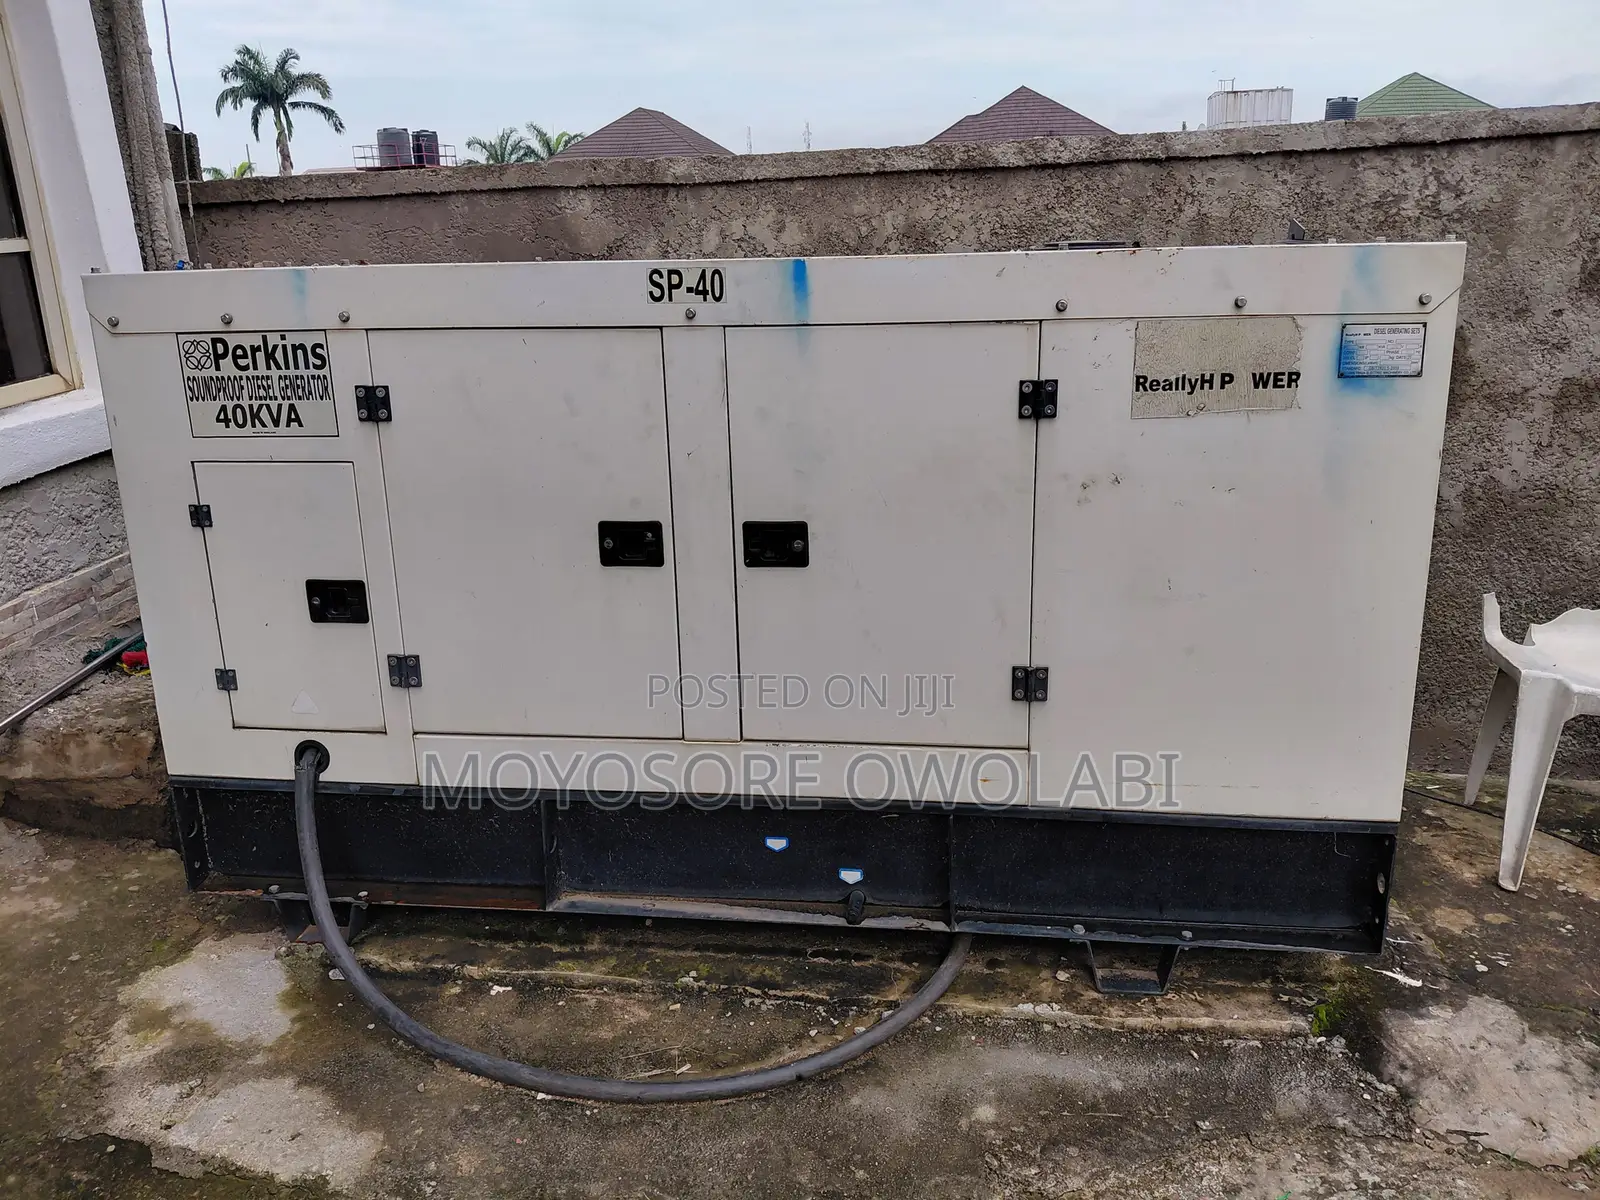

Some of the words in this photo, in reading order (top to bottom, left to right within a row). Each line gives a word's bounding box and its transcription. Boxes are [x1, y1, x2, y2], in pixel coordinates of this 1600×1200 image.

[648, 268, 724, 302] SP-40
[210, 334, 327, 371] Perkins
[186, 375, 245, 402] SOUNDPROOF
[246, 375, 278, 401] DIESEL
[277, 374, 331, 401] GENERATOR
[1252, 372, 1301, 389] WER
[215, 403, 304, 429] 40KVA
